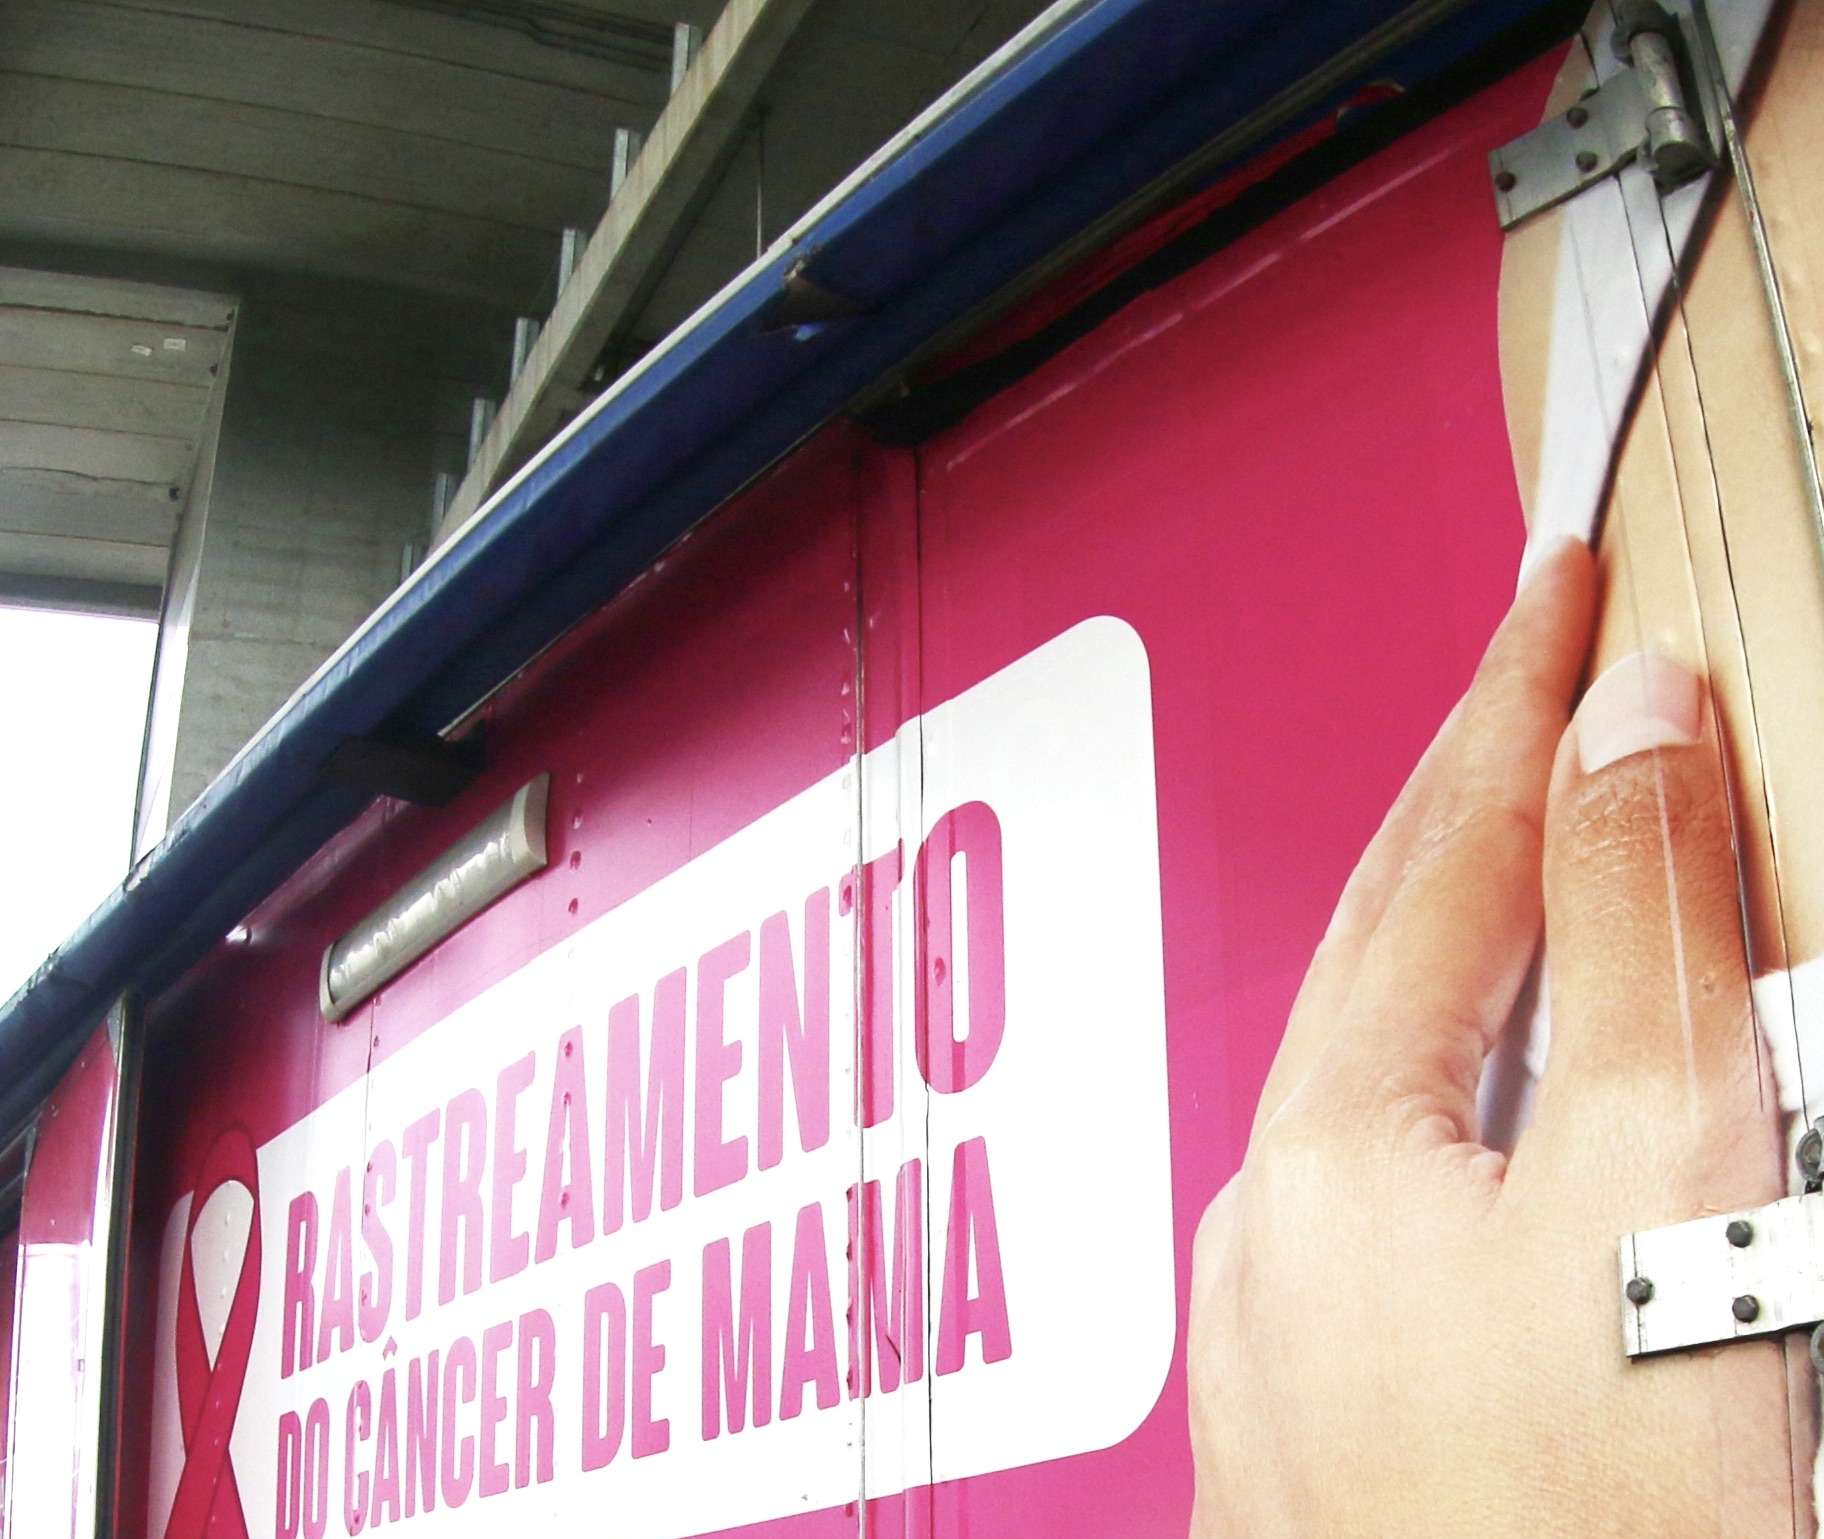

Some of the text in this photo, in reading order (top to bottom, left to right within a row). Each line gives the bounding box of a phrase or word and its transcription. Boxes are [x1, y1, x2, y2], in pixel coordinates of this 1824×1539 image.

[281, 800, 1007, 1380] RASTREAMENTO
[343, 1307, 557, 1538] CÂNCER
[580, 1258, 672, 1472] DE
[701, 1134, 1013, 1442] MAMA
